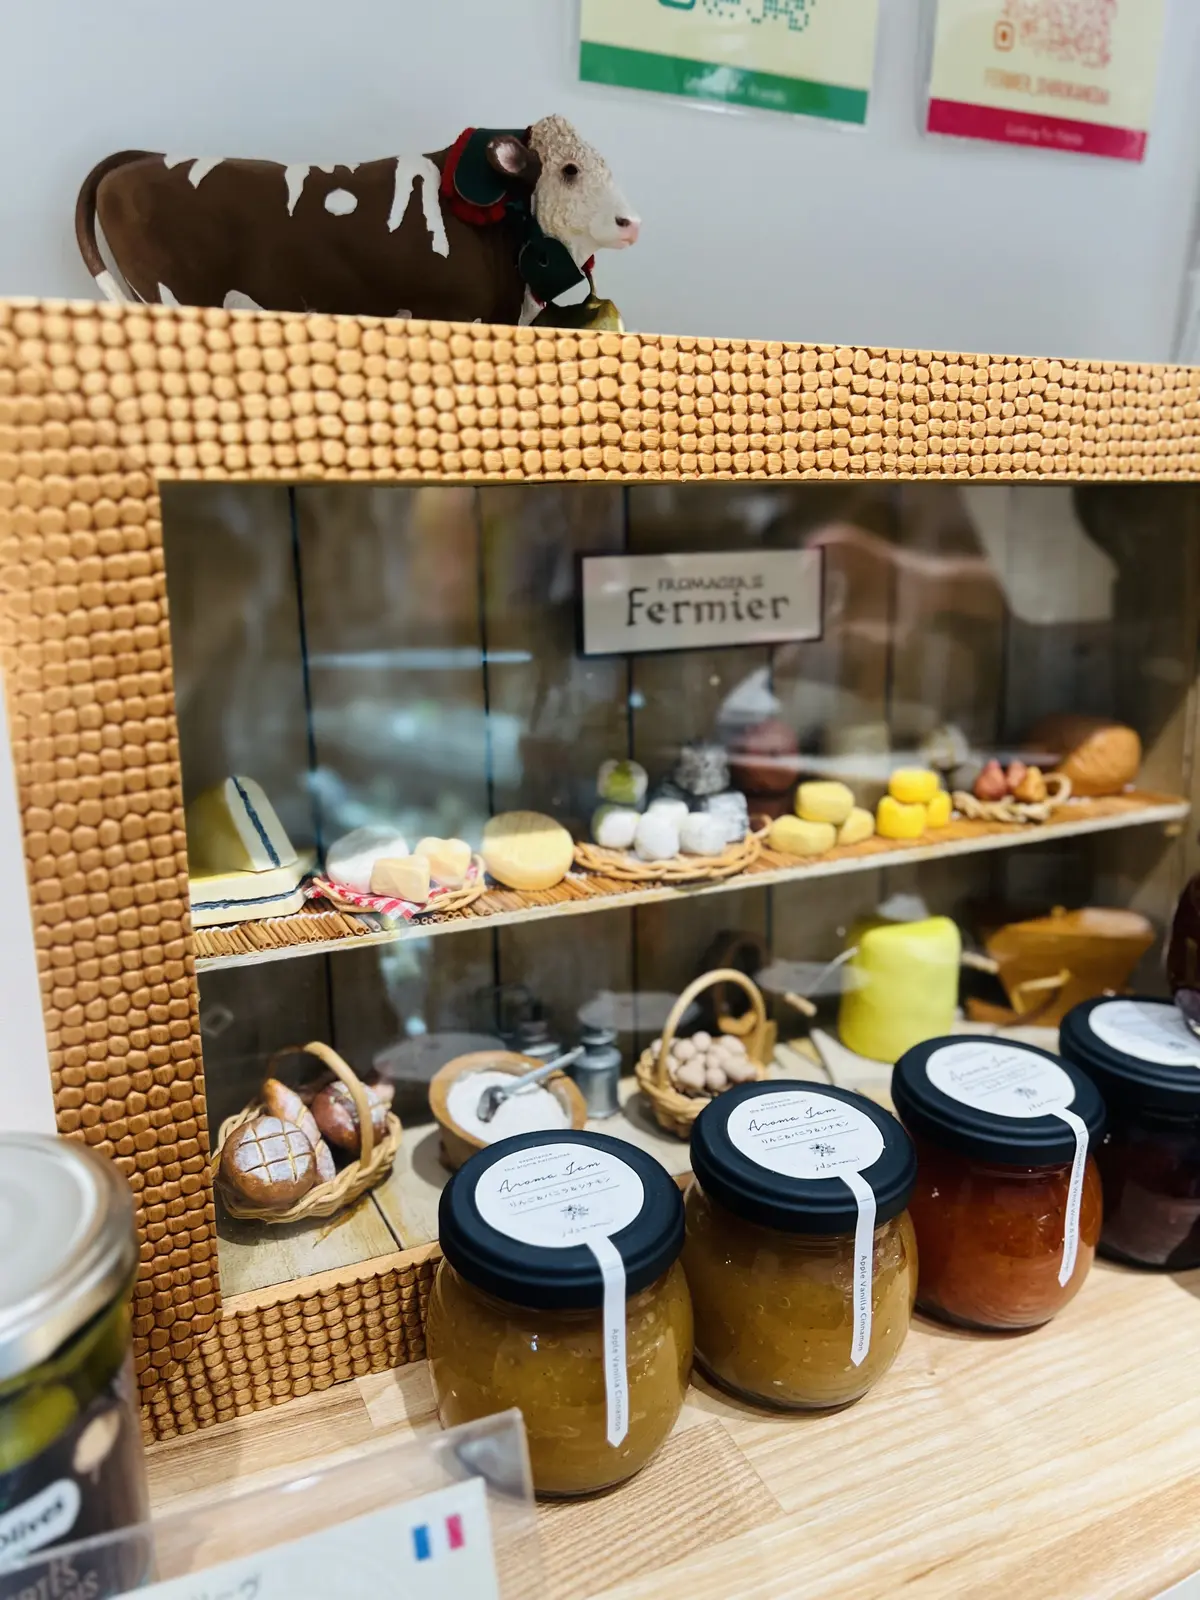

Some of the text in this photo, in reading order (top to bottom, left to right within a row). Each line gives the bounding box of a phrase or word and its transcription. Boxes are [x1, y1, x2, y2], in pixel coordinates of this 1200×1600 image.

[626, 586, 790, 627] Fermier
[748, 1116, 800, 1132] Aroma
[497, 1174, 557, 1194] Aroma
[857, 1255, 868, 1352] Apple Vanilla Cinnamon
[611, 1328, 623, 1432] Apple Vanilla Cinnamon
